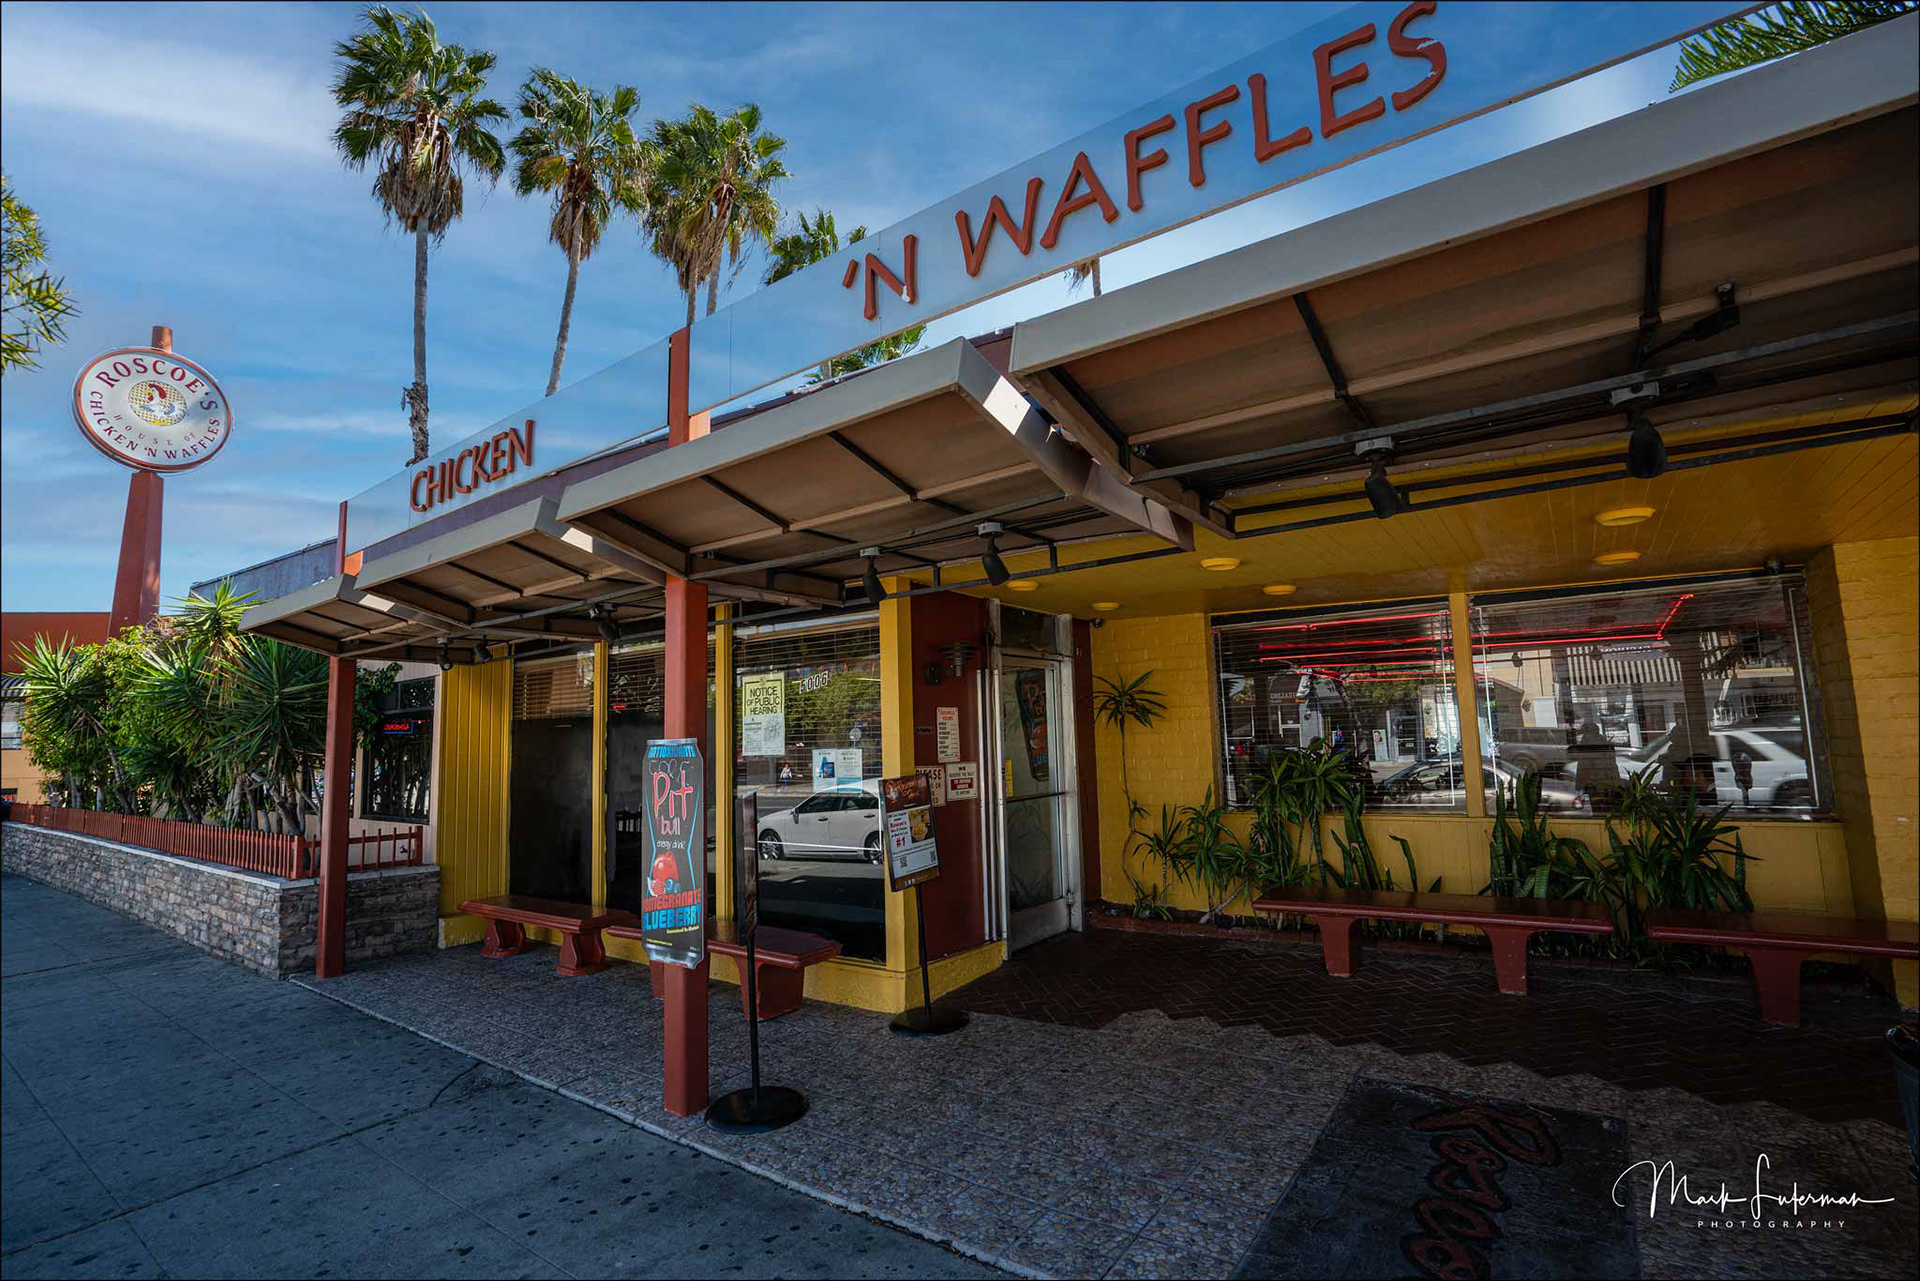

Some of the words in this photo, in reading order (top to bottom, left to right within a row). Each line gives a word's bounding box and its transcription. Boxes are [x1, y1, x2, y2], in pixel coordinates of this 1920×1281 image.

[842, 233, 917, 321] 'N
[955, 1, 1447, 279] WAFFLES
[95, 357, 218, 411] ROSCOE'S
[90, 391, 139, 451] CHICKEN
[144, 446, 158, 457] 'N
[164, 418, 220, 459] WAFFLES
[113, 414, 174, 446] HOUSE
[410, 419, 536, 513] CHICKEN
[750, 686, 778, 698] NOTICE
[800, 672, 828, 693] 5006
[747, 699, 754, 707] OF
[755, 696, 780, 707] PUBLIC
[750, 705, 778, 716] HEARING
[652, 769, 694, 821] Pit
[661, 815, 681, 836] bull
[895, 836, 906, 848] #1
